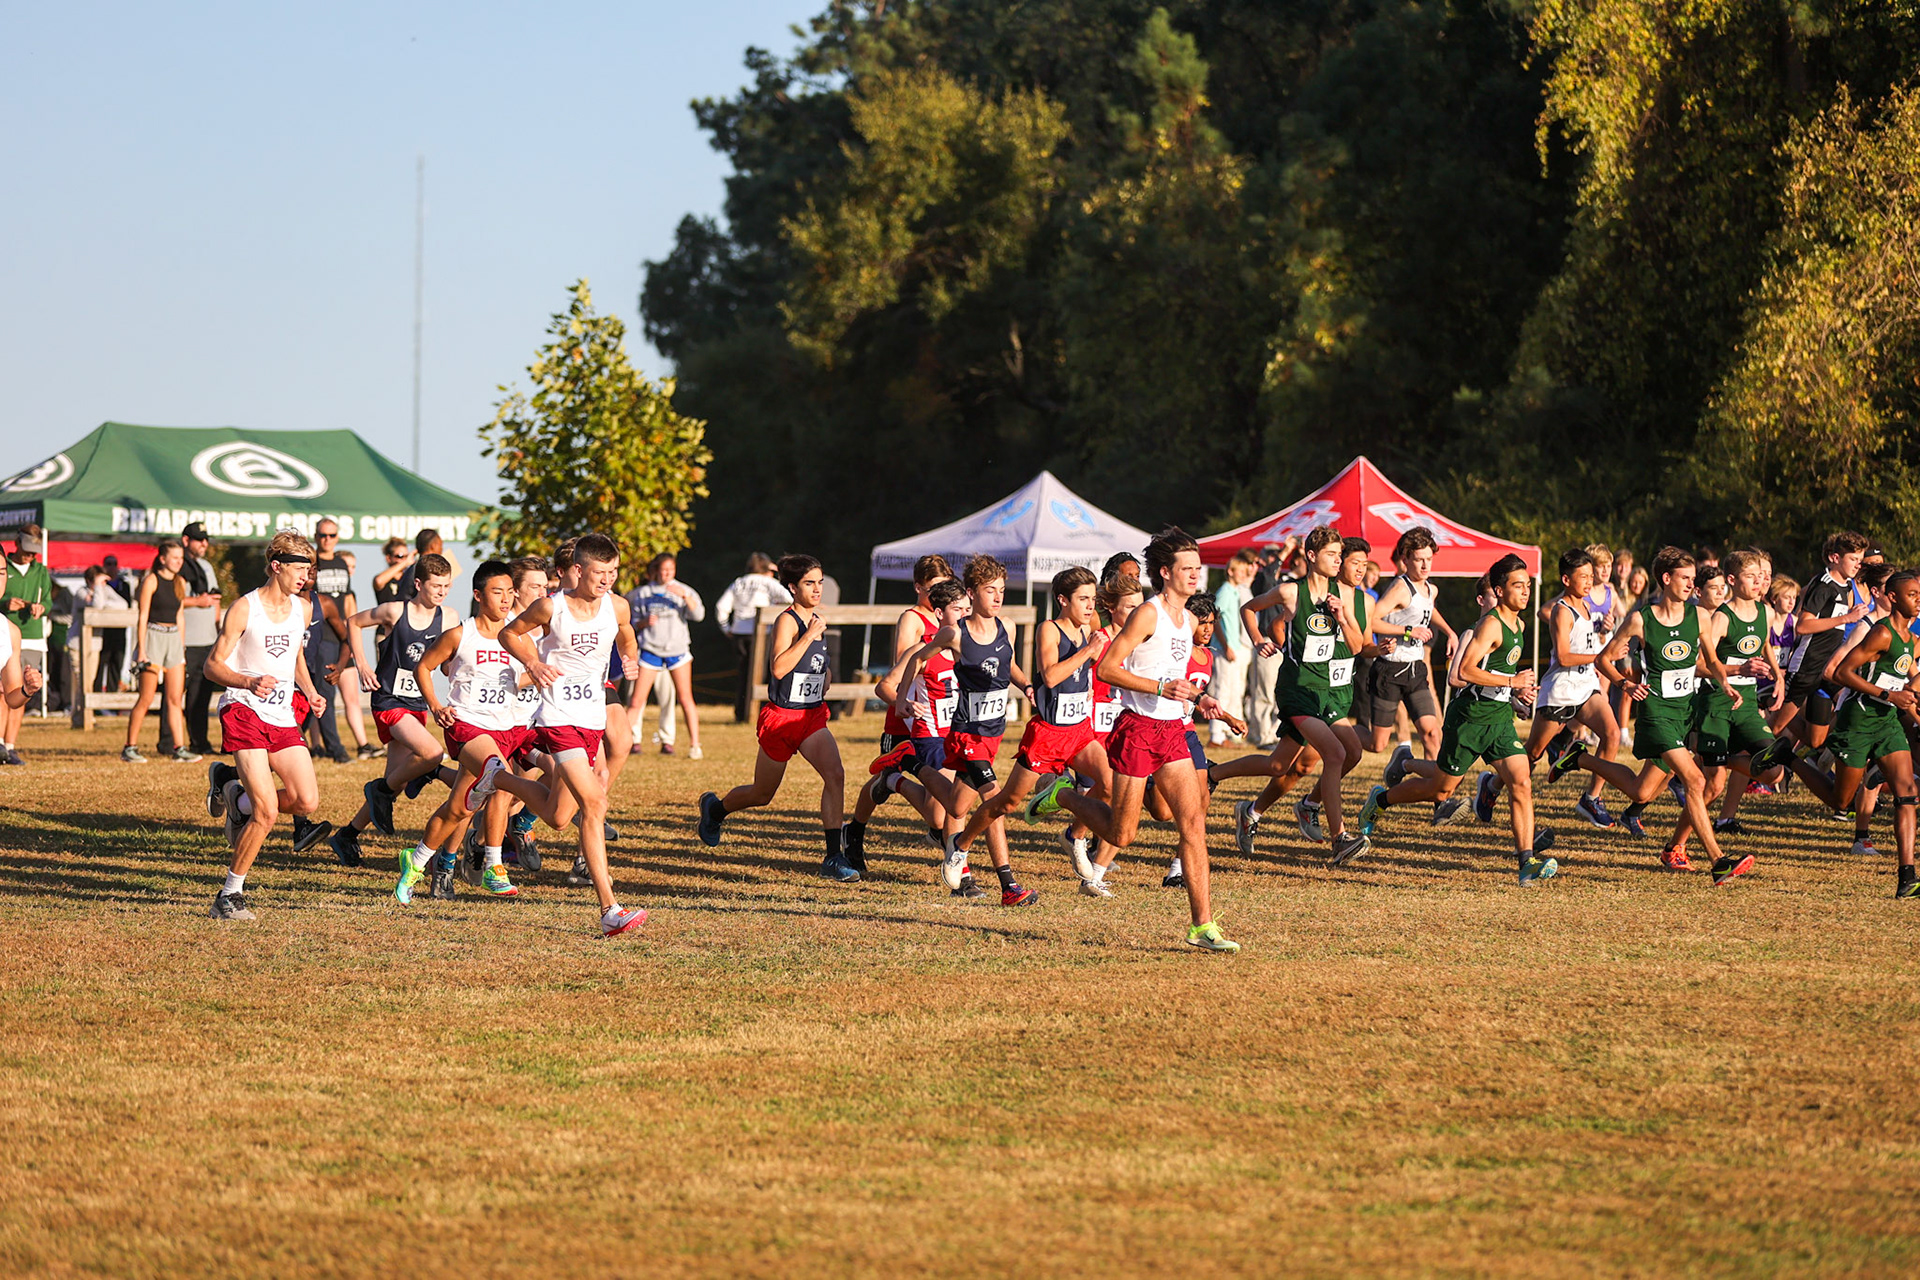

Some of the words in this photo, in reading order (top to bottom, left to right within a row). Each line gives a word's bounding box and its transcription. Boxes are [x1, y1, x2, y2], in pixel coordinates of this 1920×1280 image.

[276, 512, 355, 540] CROS
[360, 515, 471, 541] COUNTRY
[264, 634, 290, 648] ECS
[571, 632, 599, 646] ECS
[1170, 637, 1187, 653] ECS
[476, 650, 511, 665] ECS
[1317, 643, 1329, 657] 61
[1332, 667, 1345, 681] 67
[400, 677, 419, 692] 13
[1674, 677, 1689, 691] 66
[478, 688, 505, 704] 328
[517, 688, 540, 703] 334
[563, 684, 593, 701] 336
[974, 698, 1003, 716] 1773
[1062, 701, 1087, 718] 1342
[1099, 711, 1119, 726] 15
